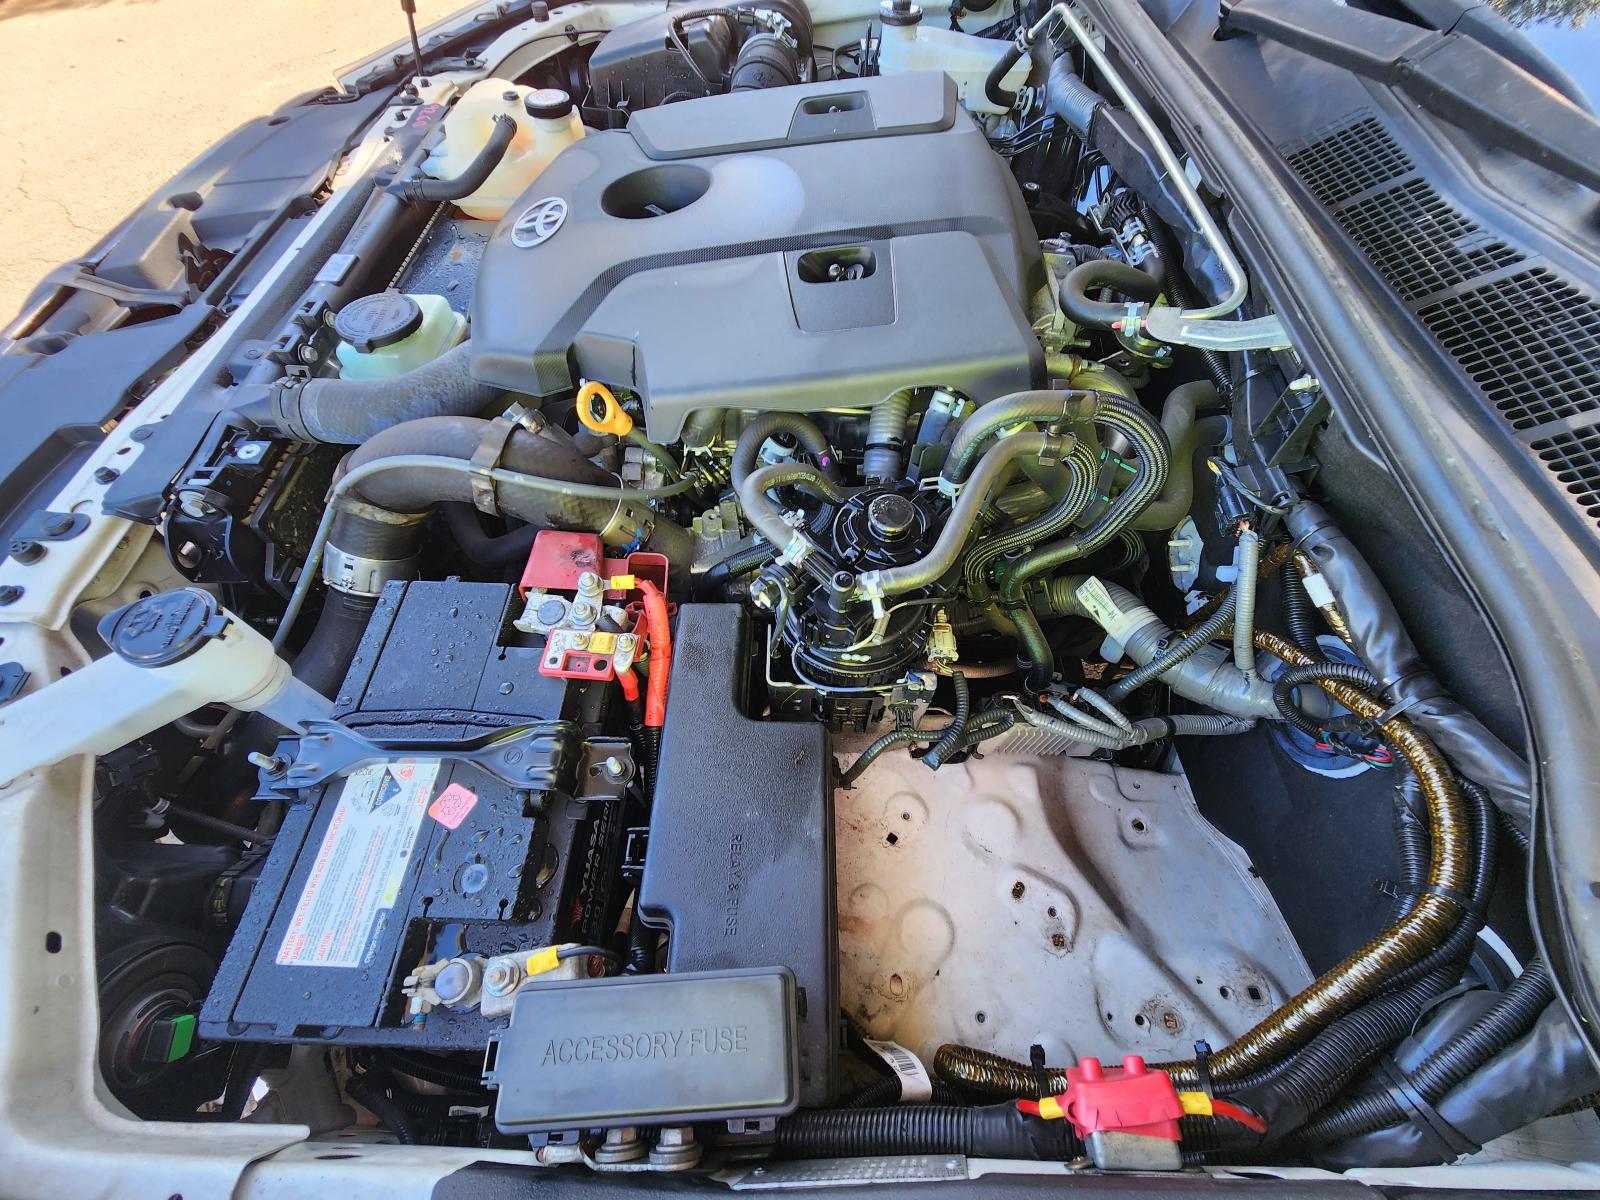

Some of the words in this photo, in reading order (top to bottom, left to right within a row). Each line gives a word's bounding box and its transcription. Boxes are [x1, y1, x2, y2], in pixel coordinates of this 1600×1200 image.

[580, 818, 600, 895] YUASA
[581, 853, 601, 934] POWER
[723, 898, 739, 937] FUSE
[541, 1029, 684, 1067] ACCESSORY
[690, 1025, 749, 1057] FUSE
